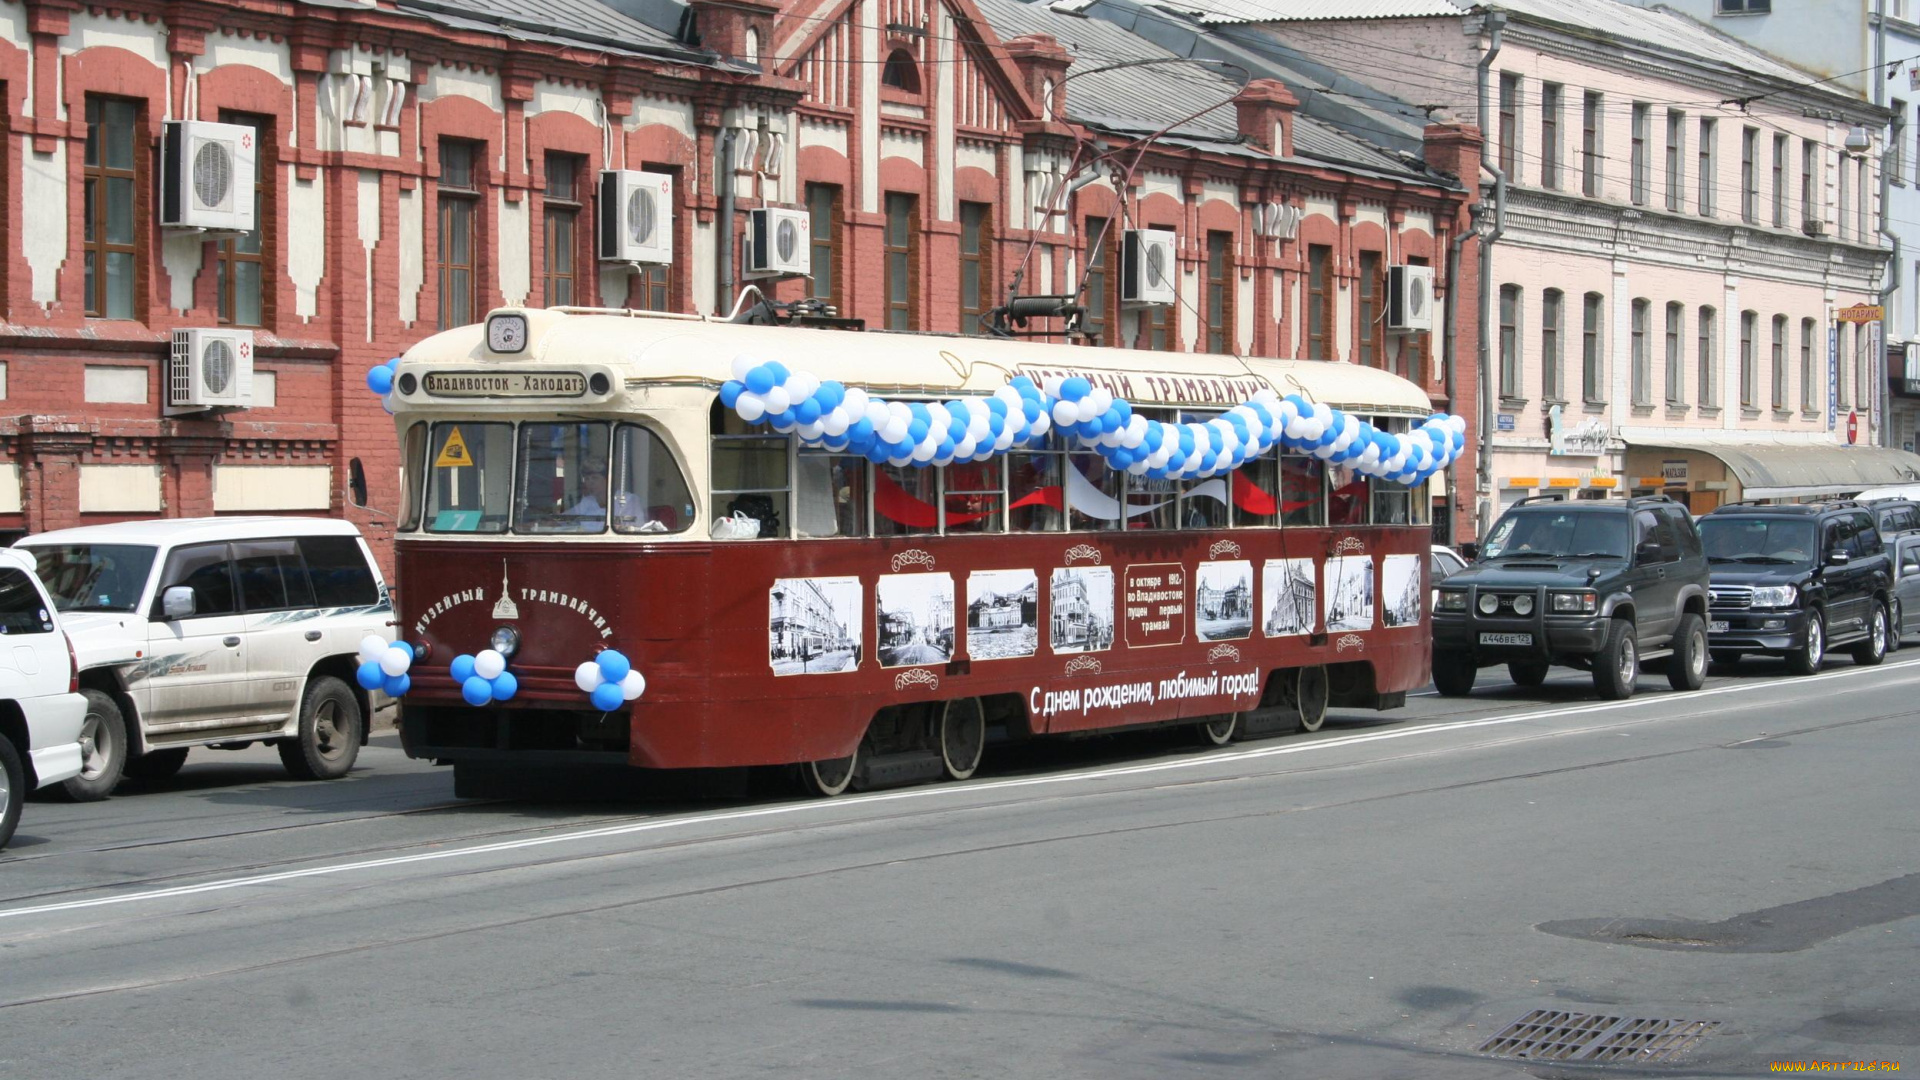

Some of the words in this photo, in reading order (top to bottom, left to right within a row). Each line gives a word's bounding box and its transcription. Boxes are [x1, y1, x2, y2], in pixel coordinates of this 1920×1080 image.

[1841, 309, 1880, 319] НОТАРИУС
[428, 375, 509, 391] Владивосток
[523, 375, 584, 391] Хакодатэ
[1130, 578, 1135, 588] в
[1136, 577, 1162, 590] октябре
[1128, 592, 1136, 603] во
[1136, 590, 1183, 604] Владивостоке
[414, 586, 485, 636] МУЗЕЙНЫЙ
[521, 588, 613, 640] ТРАМВАЙЧИК
[1128, 606, 1148, 620] пущен
[1159, 603, 1183, 619] первый
[1141, 619, 1170, 637] трамвай
[1517, 634, 1530, 643] 125
[273, 681, 296, 691] GDI
[1030, 686, 1041, 714] С
[1042, 688, 1080, 717] днем
[1083, 681, 1155, 717] рождения,
[1157, 670, 1218, 701] любимый
[1221, 666, 1259, 701] город!
